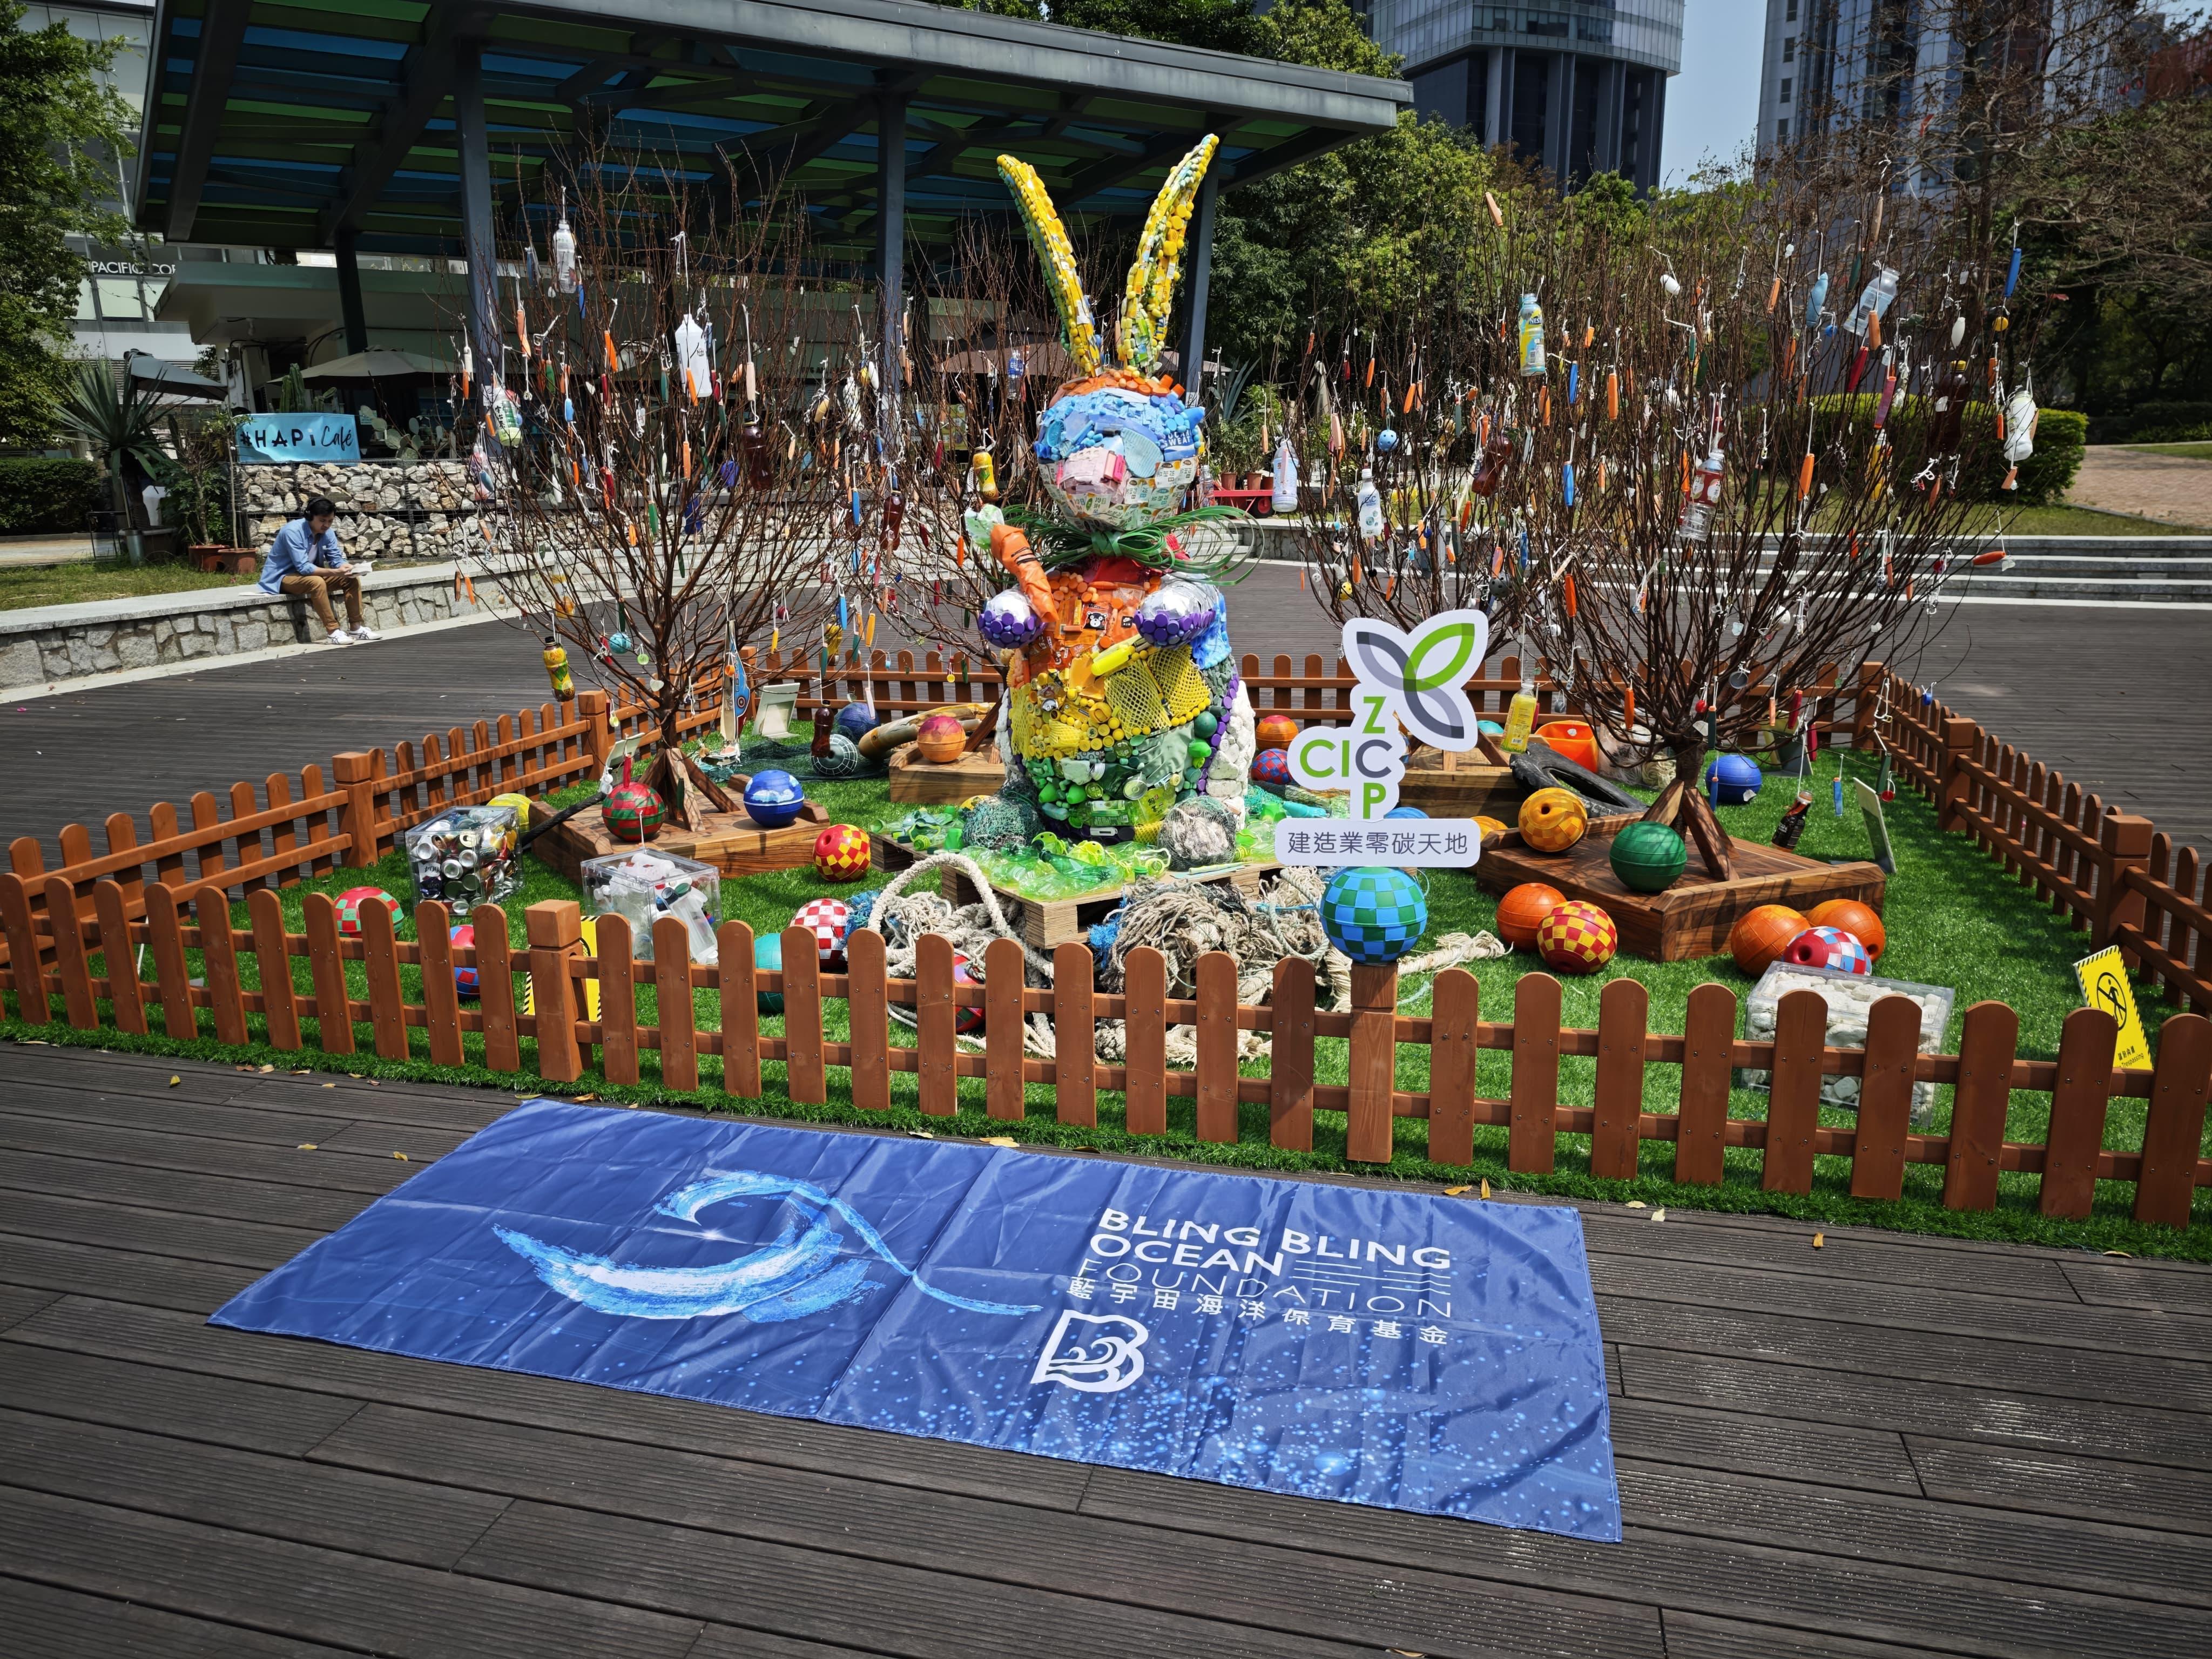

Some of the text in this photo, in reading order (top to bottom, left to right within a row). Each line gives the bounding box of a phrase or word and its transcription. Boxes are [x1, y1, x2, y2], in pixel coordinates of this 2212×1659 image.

[321, 426, 353, 451] Café
[1287, 831, 1468, 855] 建造業零碳天地
[1090, 1236, 1284, 1277] OCEAN
[1098, 1208, 1451, 1270] BLING BLING
[1066, 1276, 1448, 1345] 藍宇宙海洋保育基金
[1077, 1258, 1451, 1318] FOUNDATION
